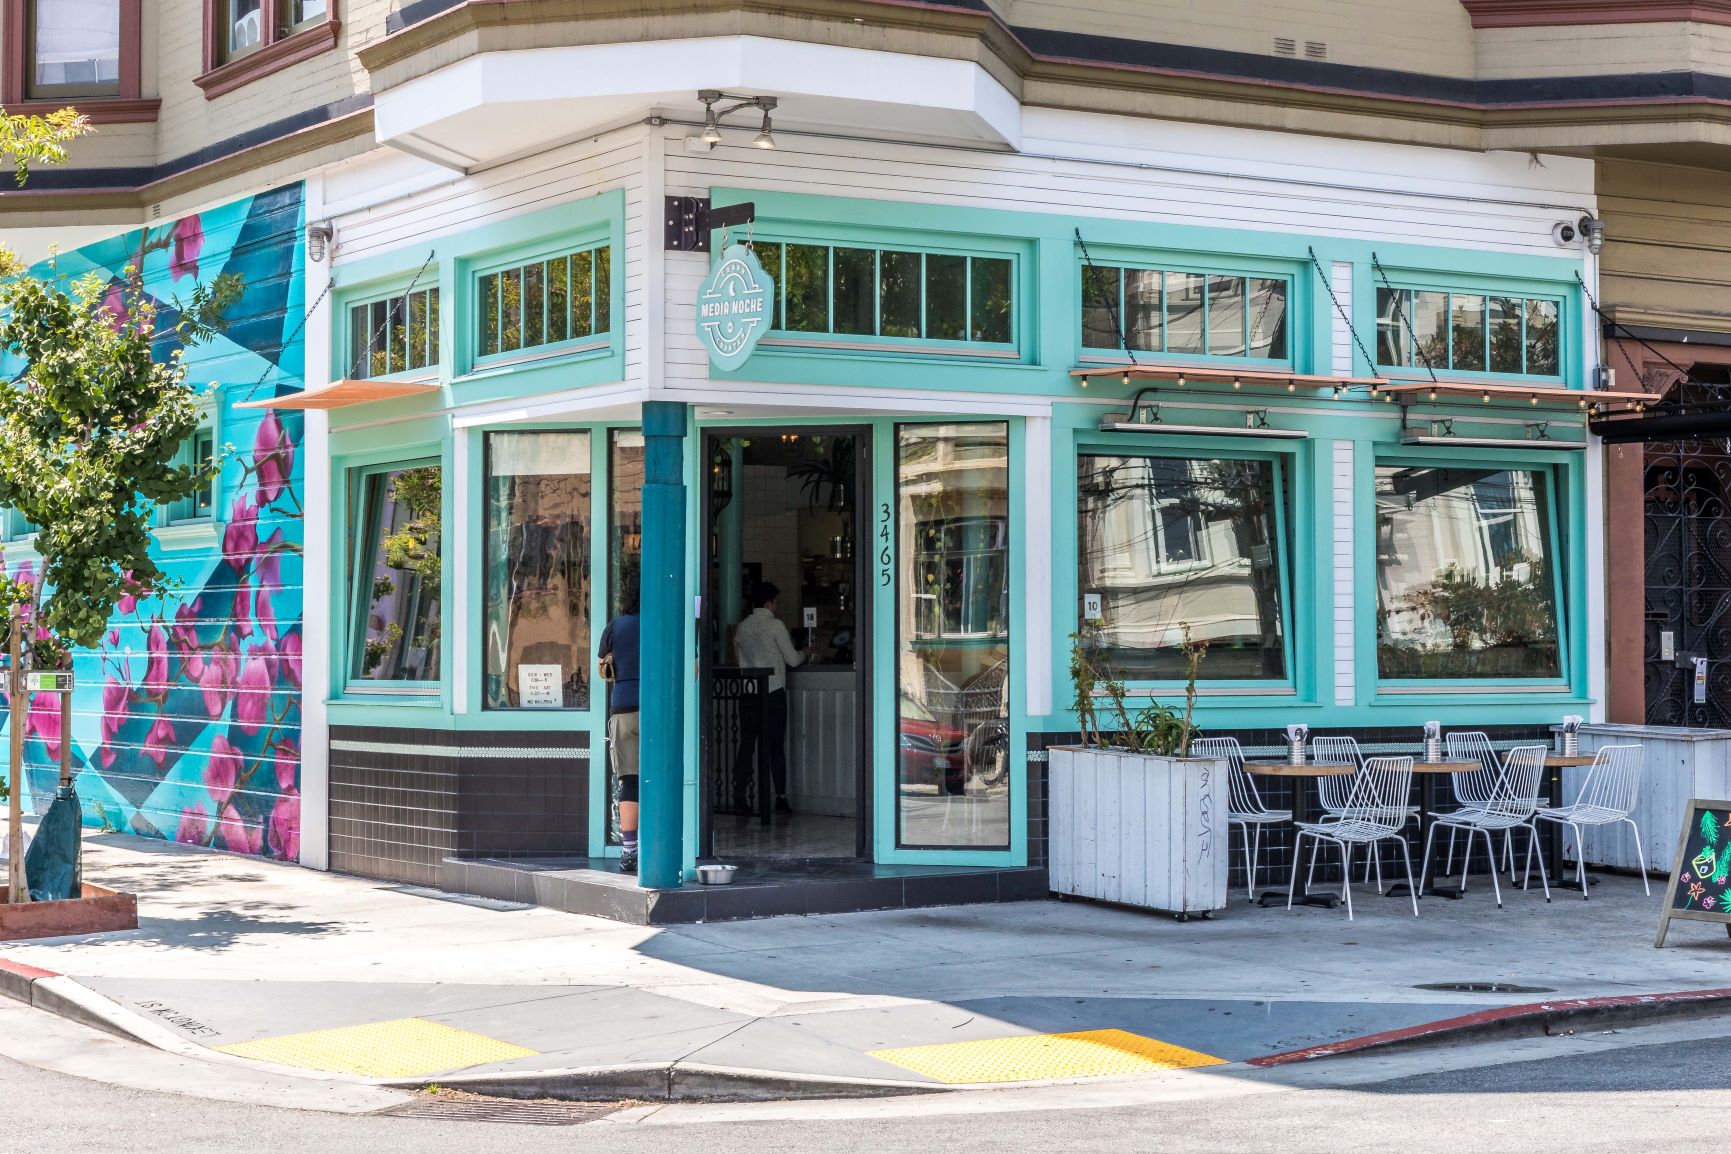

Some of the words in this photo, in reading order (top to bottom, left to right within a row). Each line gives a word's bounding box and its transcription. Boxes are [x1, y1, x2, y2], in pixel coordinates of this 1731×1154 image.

[701, 301, 729, 318] MEDIA
[732, 297, 764, 314] NOCHE
[880, 503, 891, 587] 3465
[1087, 601, 1098, 611] 10
